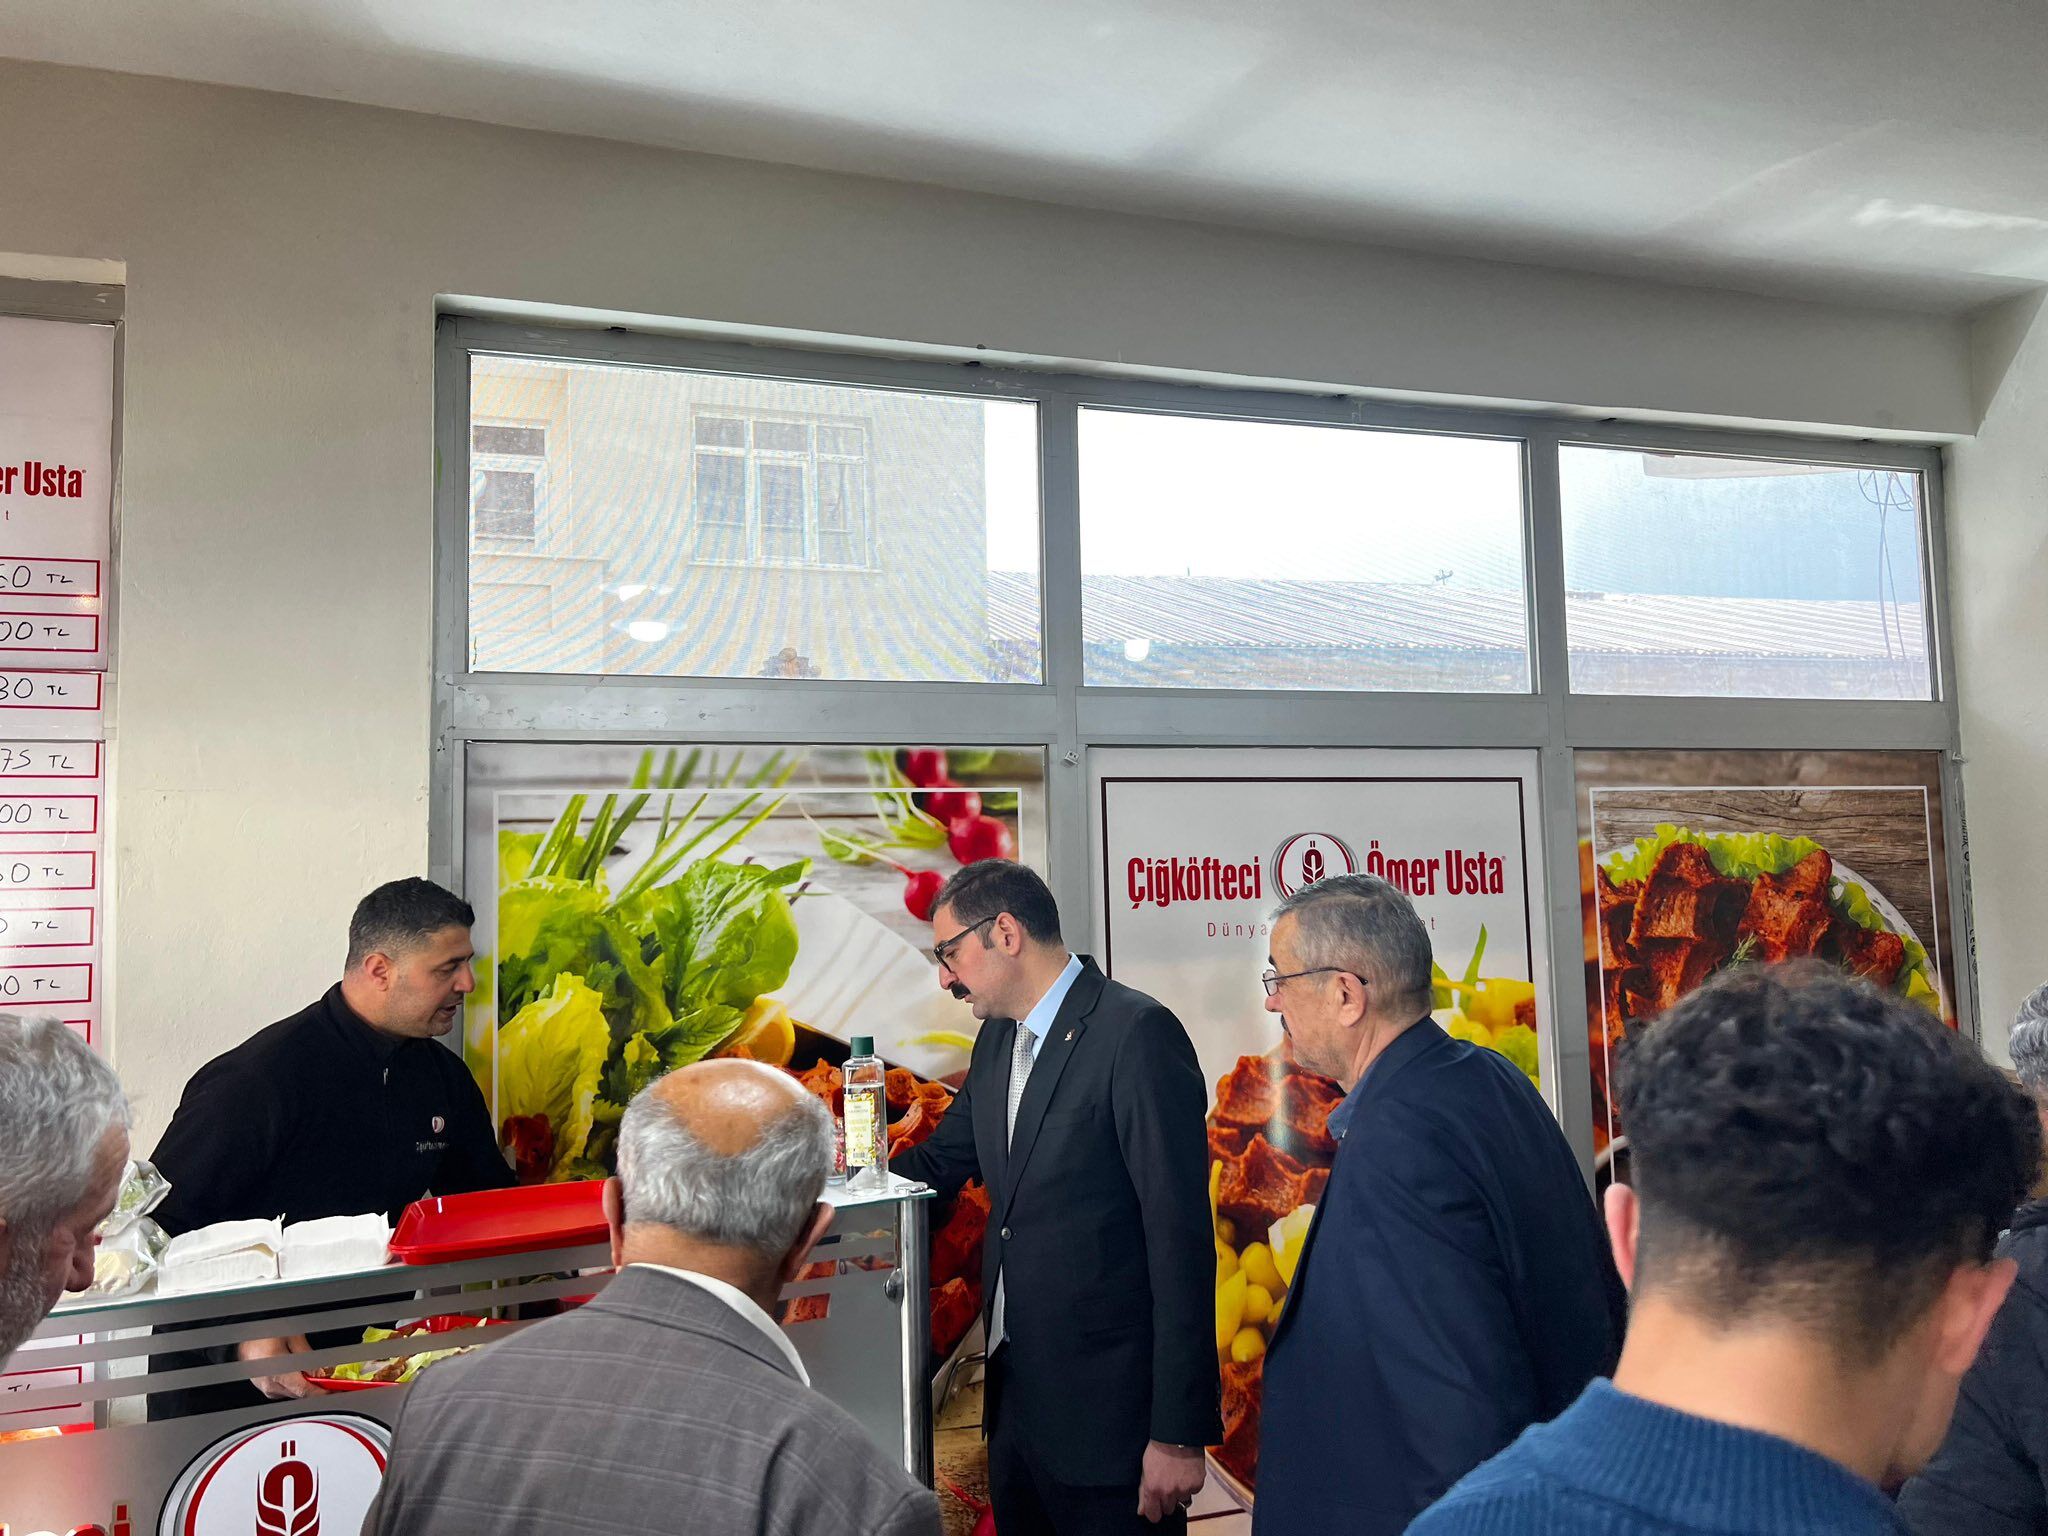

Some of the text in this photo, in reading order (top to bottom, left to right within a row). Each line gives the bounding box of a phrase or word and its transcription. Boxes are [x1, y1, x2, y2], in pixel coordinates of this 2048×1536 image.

[24, 461, 82, 498] Usta
[46, 573, 73, 584] TL
[43, 626, 70, 637] TL
[46, 685, 68, 696] TL
[48, 754, 74, 769] TL
[44, 807, 70, 819] TL
[1127, 840, 1504, 909] Çiğköfteci Ömer Usta
[31, 920, 59, 930] TL
[33, 978, 61, 990] TL
